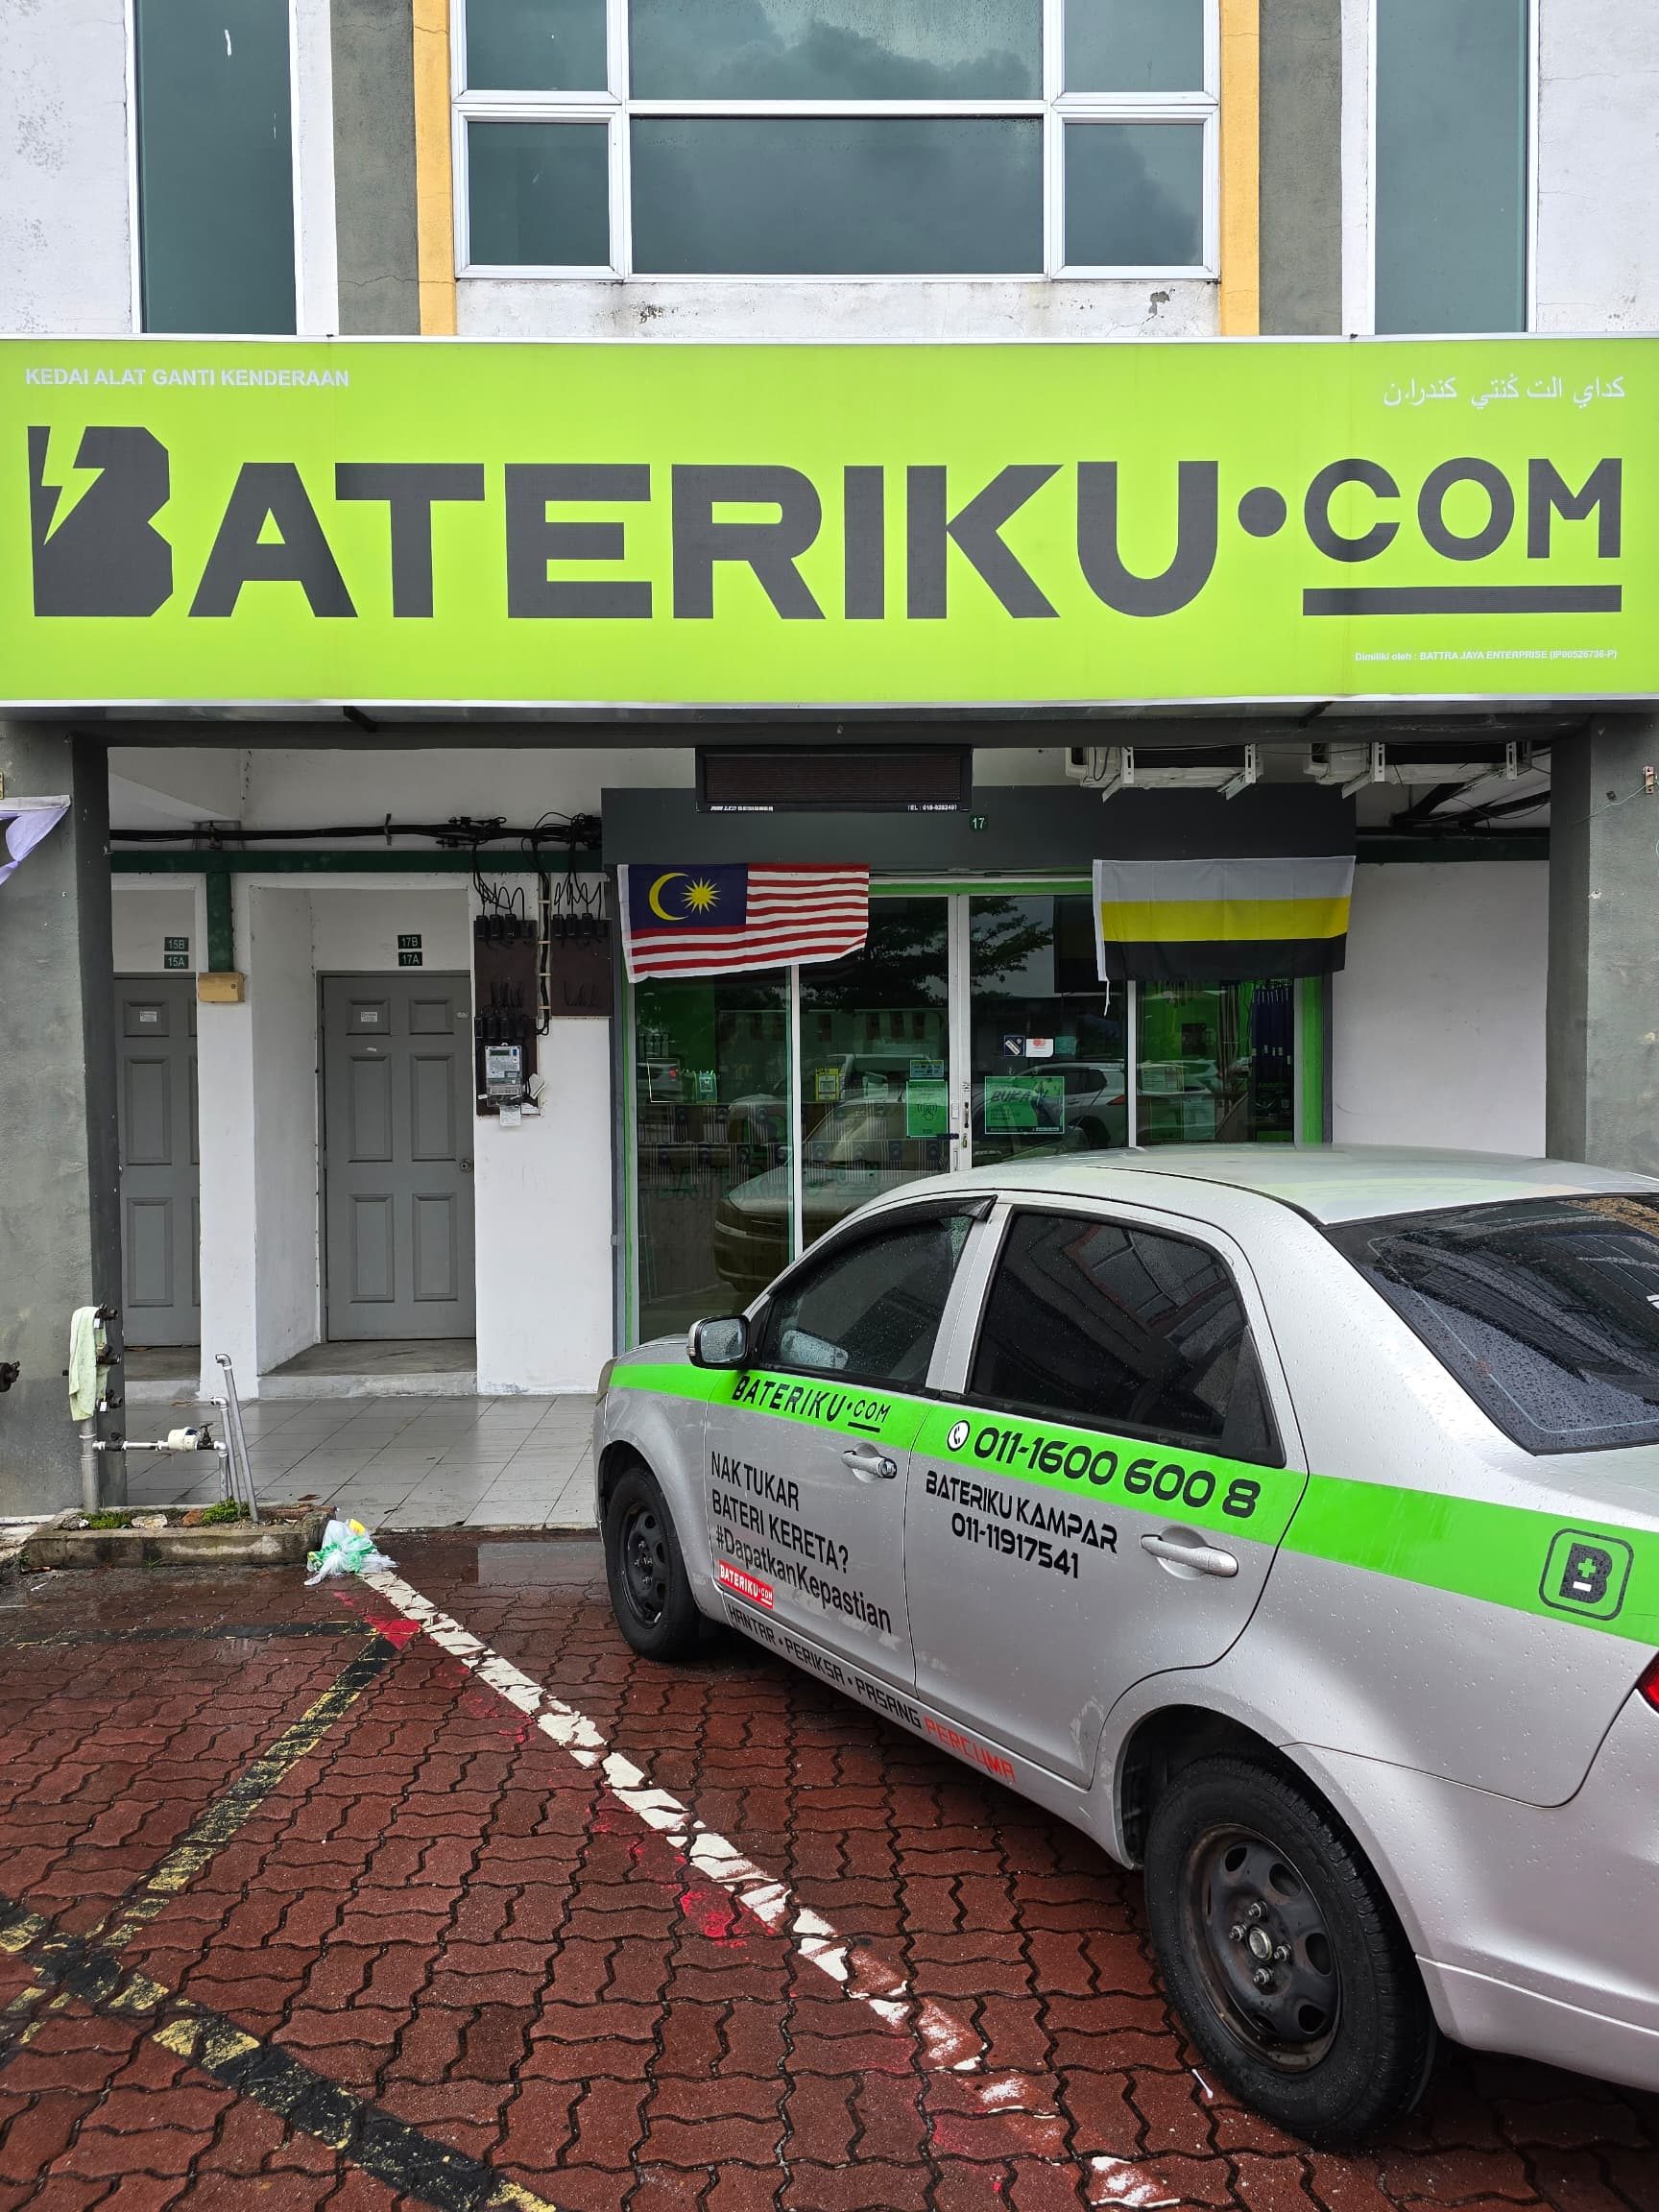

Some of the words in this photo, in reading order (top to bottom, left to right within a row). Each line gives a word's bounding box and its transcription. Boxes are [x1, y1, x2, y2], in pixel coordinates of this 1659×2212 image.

[25, 369, 89, 385] KEDAI
[94, 369, 146, 385] ALAT
[153, 369, 214, 386] GANTI
[221, 369, 349, 387] KENDERAAN
[1420, 651, 1458, 661] BATTRA
[1460, 651, 1484, 661] JAYA
[1486, 650, 1548, 661] ENTERPRISE
[973, 817, 985, 830] 17
[168, 939, 185, 950] 15B
[401, 936, 419, 947] 17B
[402, 954, 420, 965] 17A
[168, 956, 185, 967] 15A
[711, 1451, 741, 1487] NAK
[744, 1463, 800, 1512] TUKAR
[974, 1427, 1118, 1485] 011-1600
[1123, 1458, 1216, 1508] 600
[1221, 1479, 1262, 1518] 8
[926, 1470, 1013, 1520] BATERIKU
[1016, 1496, 1118, 1553] KAMPAR
[712, 1489, 764, 1536] BATERI
[768, 1514, 849, 1574] KERETA?
[951, 1512, 1079, 1578] 011-11917541
[715, 1525, 892, 1634] #DapatkanKepastian
[728, 1604, 777, 1646] HANTAR
[784, 1638, 845, 1686] PERIKSA
[854, 1676, 923, 1729] PASANG
[924, 1716, 1016, 1783] PERCUMA
